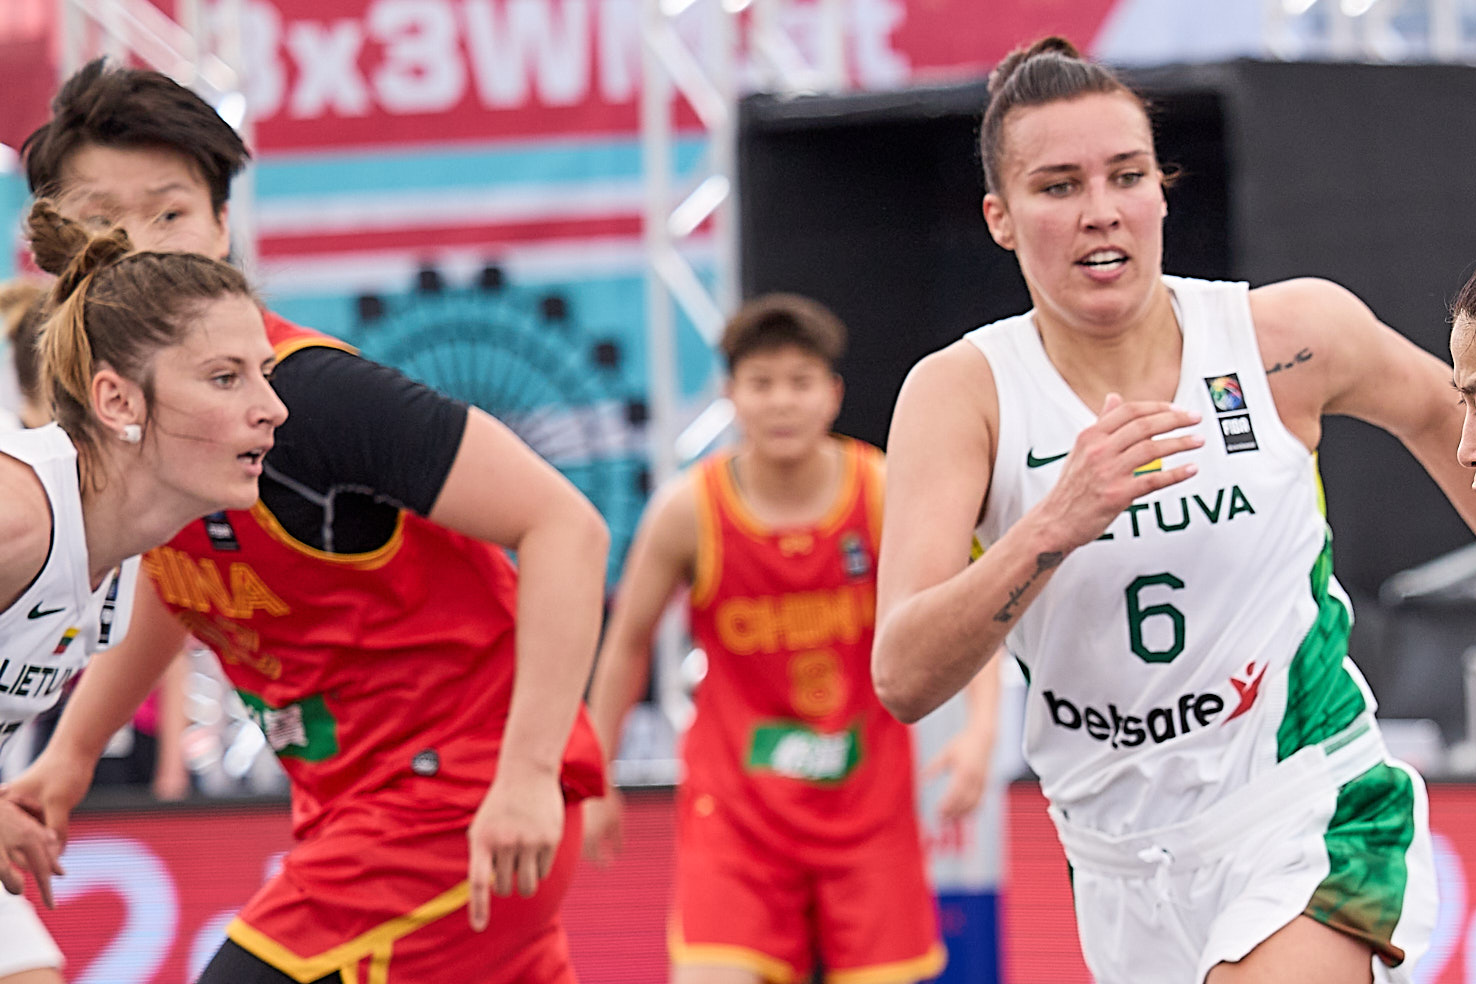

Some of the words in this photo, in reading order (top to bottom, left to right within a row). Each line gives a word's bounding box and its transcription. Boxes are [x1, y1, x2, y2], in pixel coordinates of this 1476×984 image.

[1096, 485, 1256, 541] TUVA
[1124, 571, 1186, 664] 6
[1042, 690, 1225, 750] betsafe
